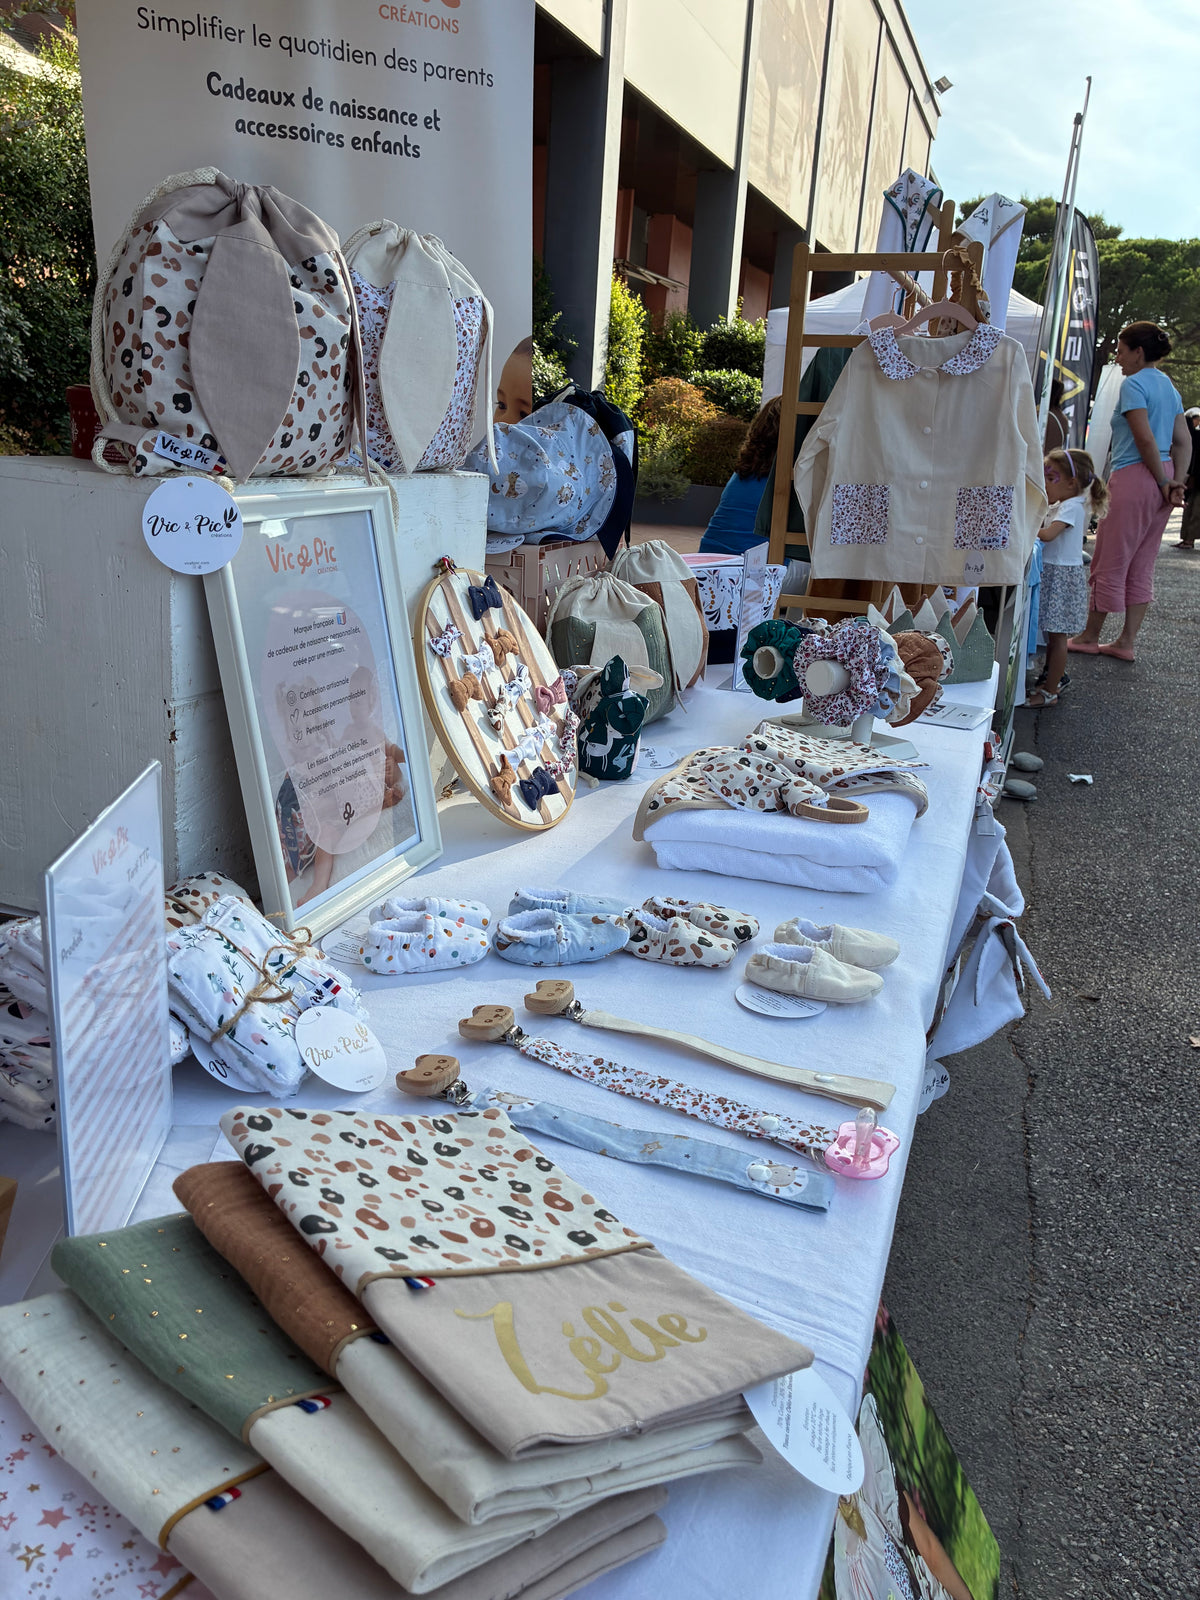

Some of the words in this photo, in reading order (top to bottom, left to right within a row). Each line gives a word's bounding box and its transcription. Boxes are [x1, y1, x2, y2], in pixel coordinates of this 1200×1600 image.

[378, 4, 460, 34] CRÉATIONS
[136, 6, 246, 44] Simplifier
[252, 23, 272, 48] le
[278, 35, 377, 67] quotidien
[383, 47, 418, 74] des
[423, 61, 494, 87] parents
[206, 71, 296, 107] Cadeaux
[302, 86, 324, 112] de
[329, 98, 418, 127] naissance
[423, 108, 441, 131] et
[234, 118, 345, 148] accessoires
[351, 130, 421, 159] enfants
[161, 436, 180, 454] Vic
[194, 450, 210, 464] Pic
[147, 514, 181, 536] Vic
[194, 514, 224, 535] Pic
[265, 543, 295, 573] Vic
[313, 537, 337, 565] Pic
[293, 625, 312, 635] Marque
[313, 618, 334, 629] française
[267, 649, 274, 658] de
[275, 644, 298, 655] cadeaux
[299, 640, 306, 649] de
[306, 635, 329, 647] naissance
[292, 657, 307, 667] créée
[308, 654, 316, 664] par
[317, 651, 325, 660] une
[299, 685, 326, 699] Confection
[326, 676, 349, 690] artisanale
[302, 703, 329, 718] Accessoires
[329, 688, 366, 709] personnalisables
[298, 769, 331, 789] Collaboration
[332, 764, 343, 774] avec
[343, 760, 351, 769] des
[351, 751, 374, 765] personnes
[307, 762, 316, 770] Les
[316, 756, 328, 766] tissus
[338, 778, 345, 786] de
[305, 1046, 333, 1067] Vic
[338, 1036, 363, 1055] Pic
[208, 1059, 232, 1078] Vi
[453, 1301, 708, 1401] Zélie
